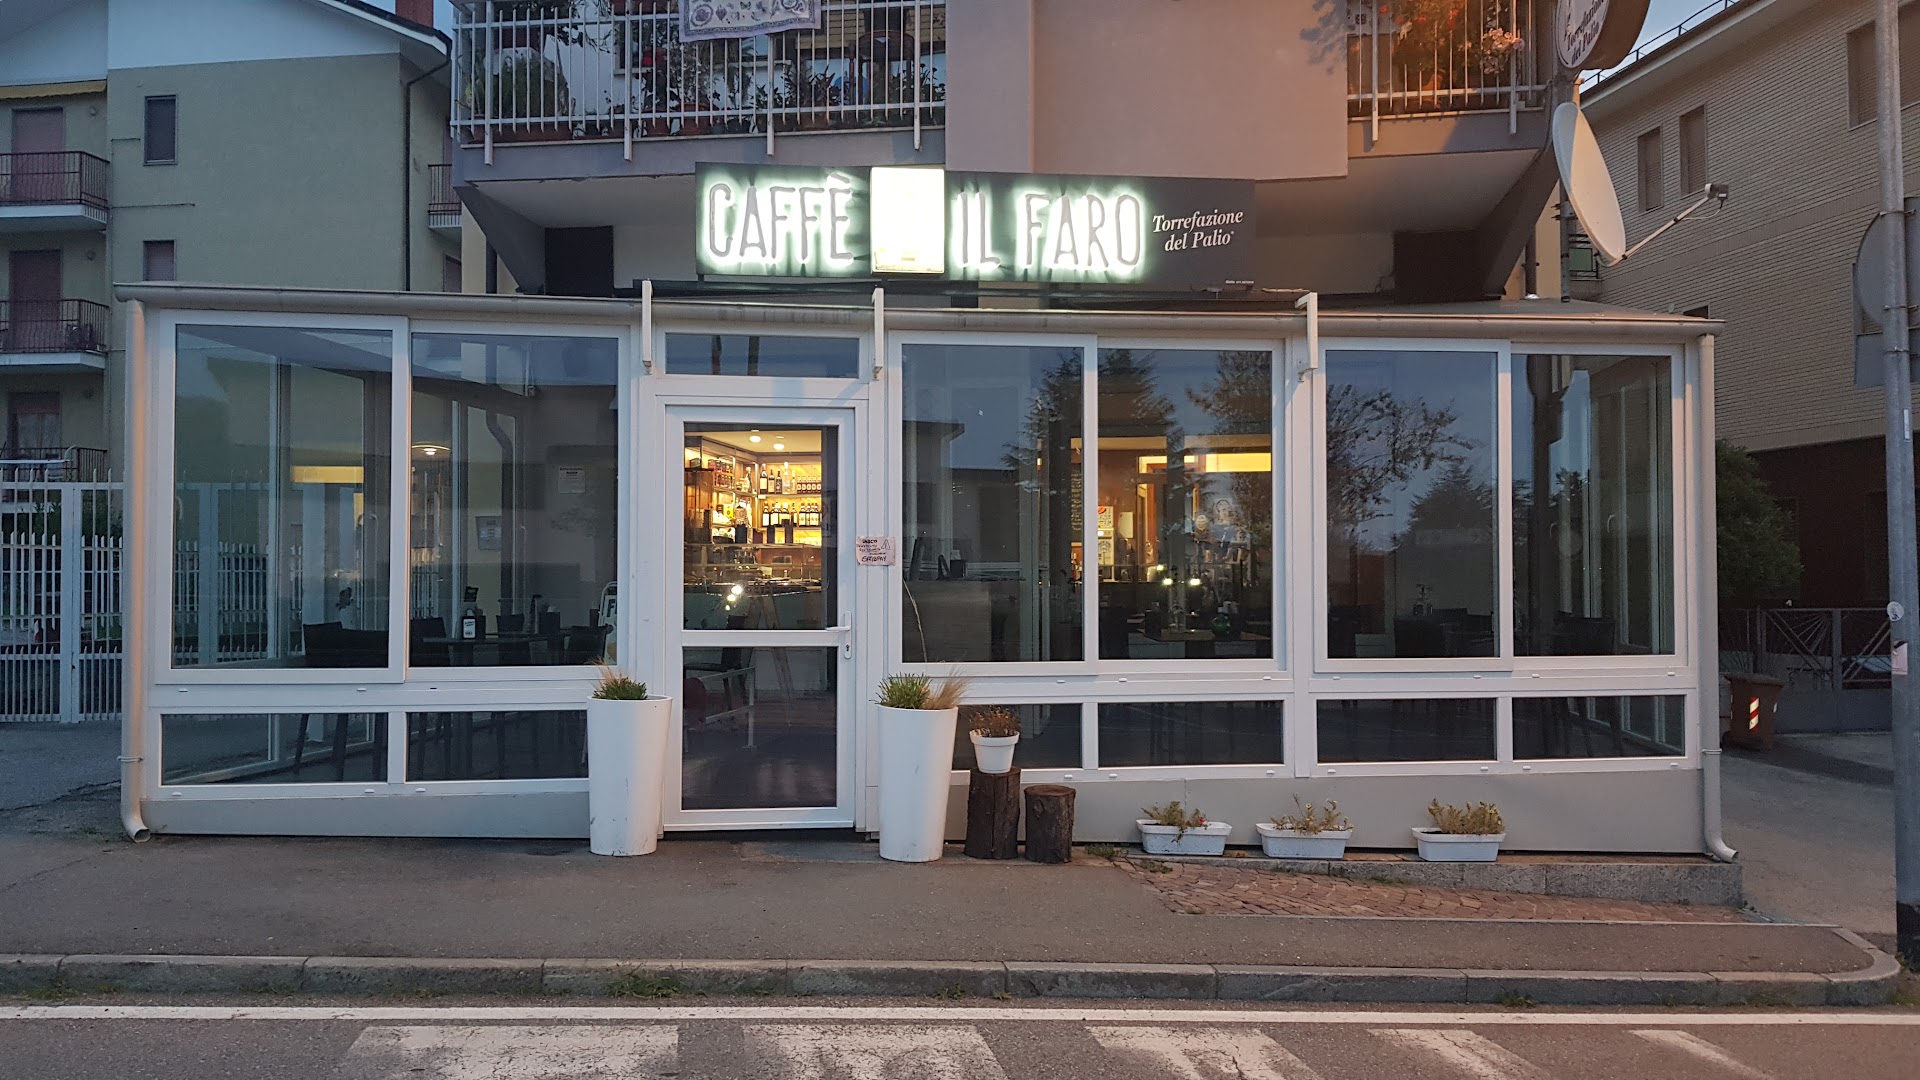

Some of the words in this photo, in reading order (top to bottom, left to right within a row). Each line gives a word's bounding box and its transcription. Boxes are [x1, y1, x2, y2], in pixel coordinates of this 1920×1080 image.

[1582, 20, 1600, 52] Palio
[709, 172, 854, 261] CAFFÈ
[957, 192, 1000, 267] IL
[1025, 194, 1141, 267] FARO
[1152, 209, 1244, 233] Torrefazione
[1164, 232, 1188, 252] del
[1191, 229, 1231, 249] Palio
